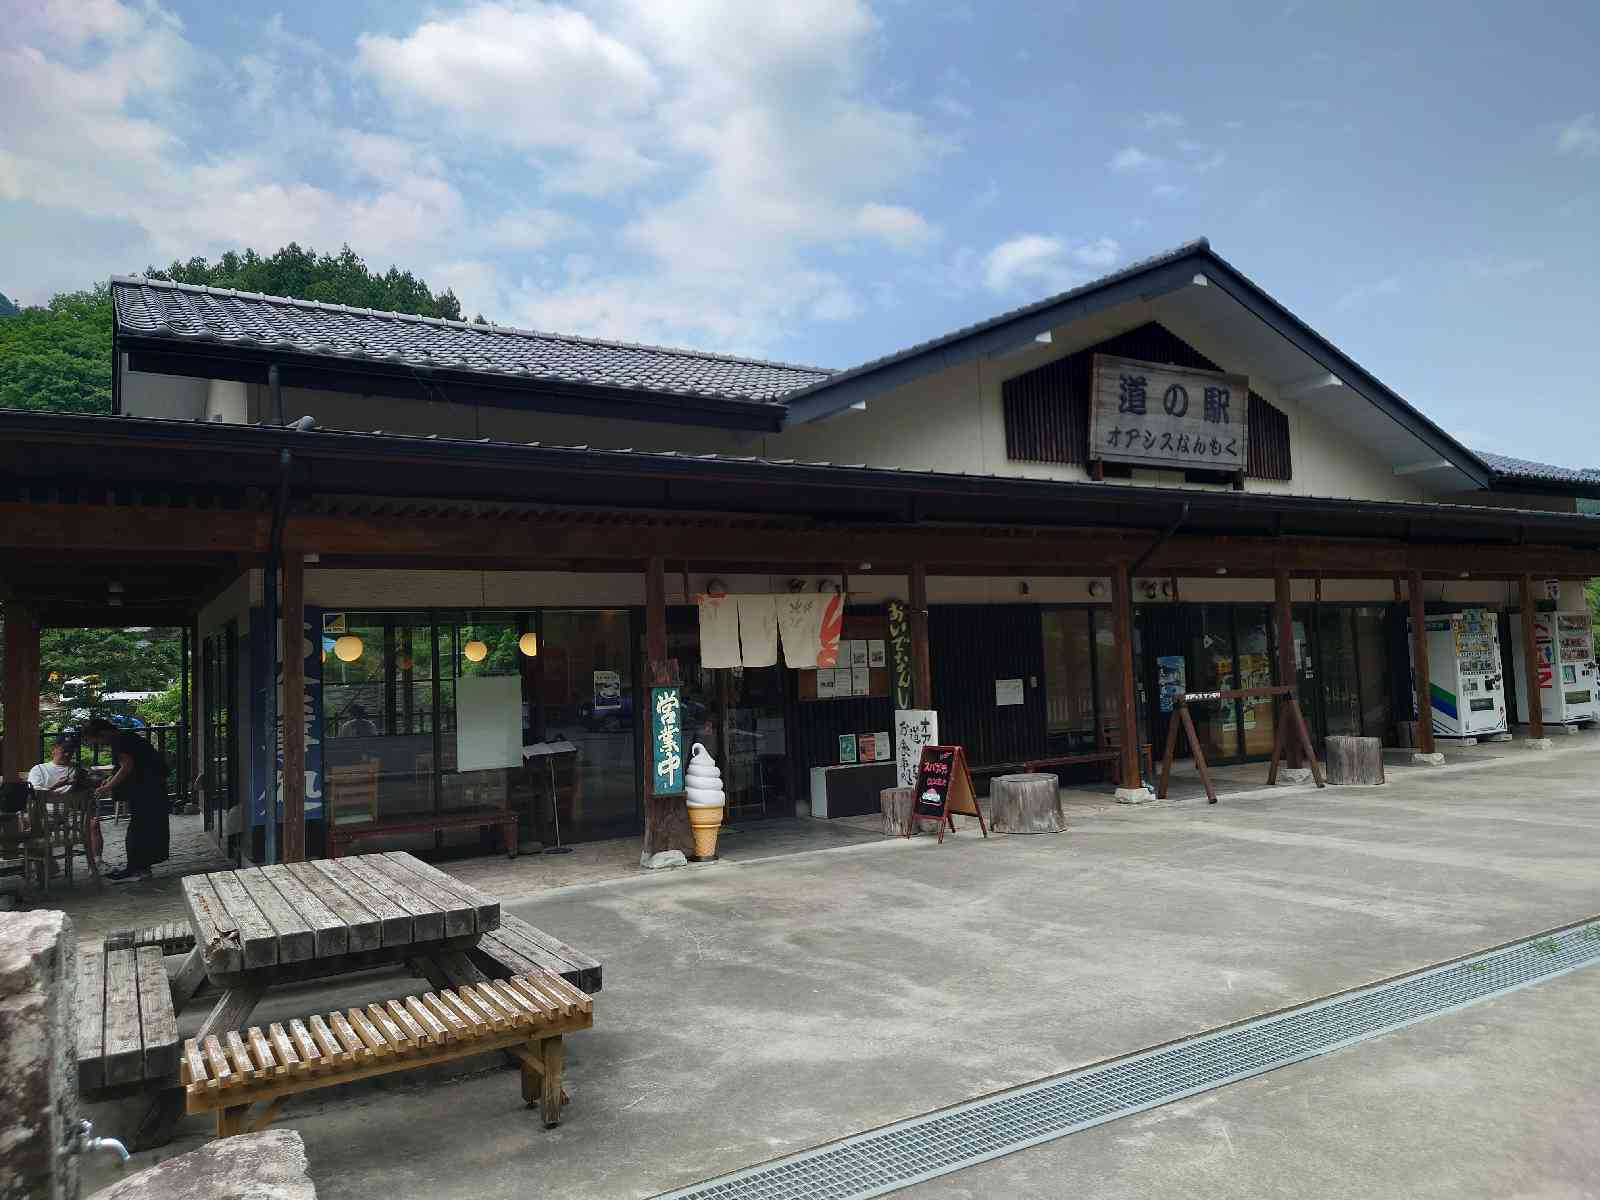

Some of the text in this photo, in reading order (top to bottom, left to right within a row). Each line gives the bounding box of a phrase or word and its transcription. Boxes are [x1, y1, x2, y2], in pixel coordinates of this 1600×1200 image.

[1118, 375, 1231, 424] 道の駅
[1107, 427, 1238, 457] オアシスなんもく
[656, 690, 681, 787] 営業中
